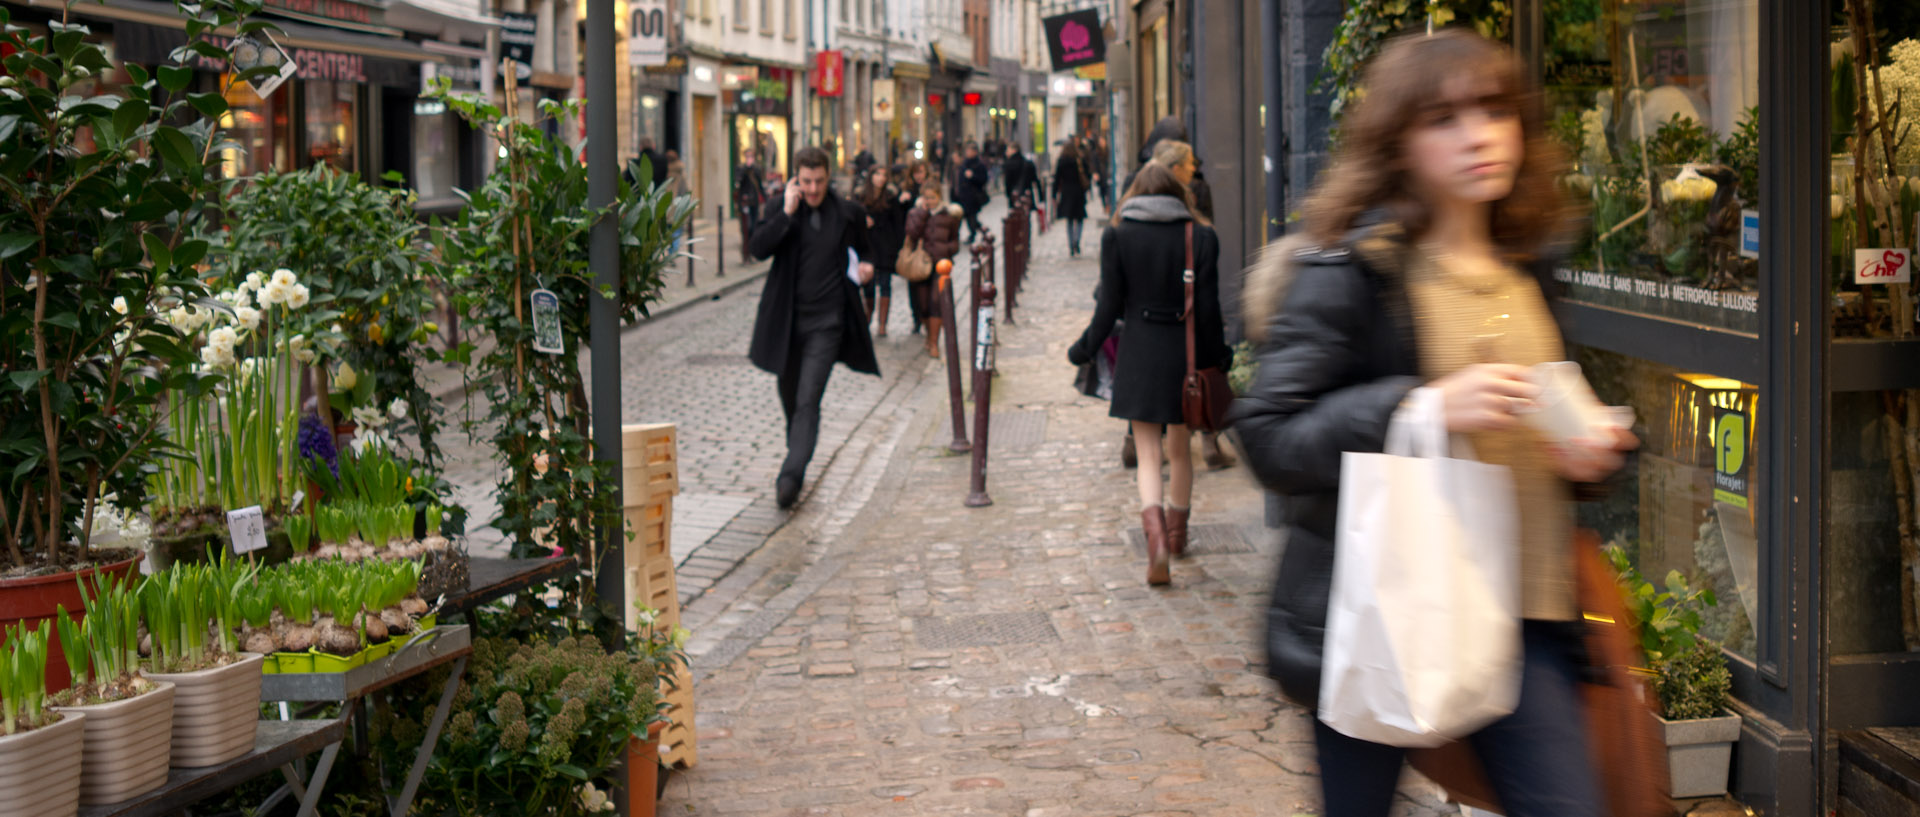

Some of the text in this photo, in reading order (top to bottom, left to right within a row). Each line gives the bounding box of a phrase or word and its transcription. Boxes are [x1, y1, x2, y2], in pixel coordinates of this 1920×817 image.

[295, 48, 367, 82] CENTRAL
[1574, 271, 1579, 284] A
[1582, 271, 1611, 290] DOMICILE
[1614, 276, 1631, 293] DANS
[1635, 279, 1657, 297] TOUTE
[1660, 283, 1669, 299] LA
[1673, 285, 1719, 307] METROPOLE
[1722, 293, 1757, 313] LILLOISE
